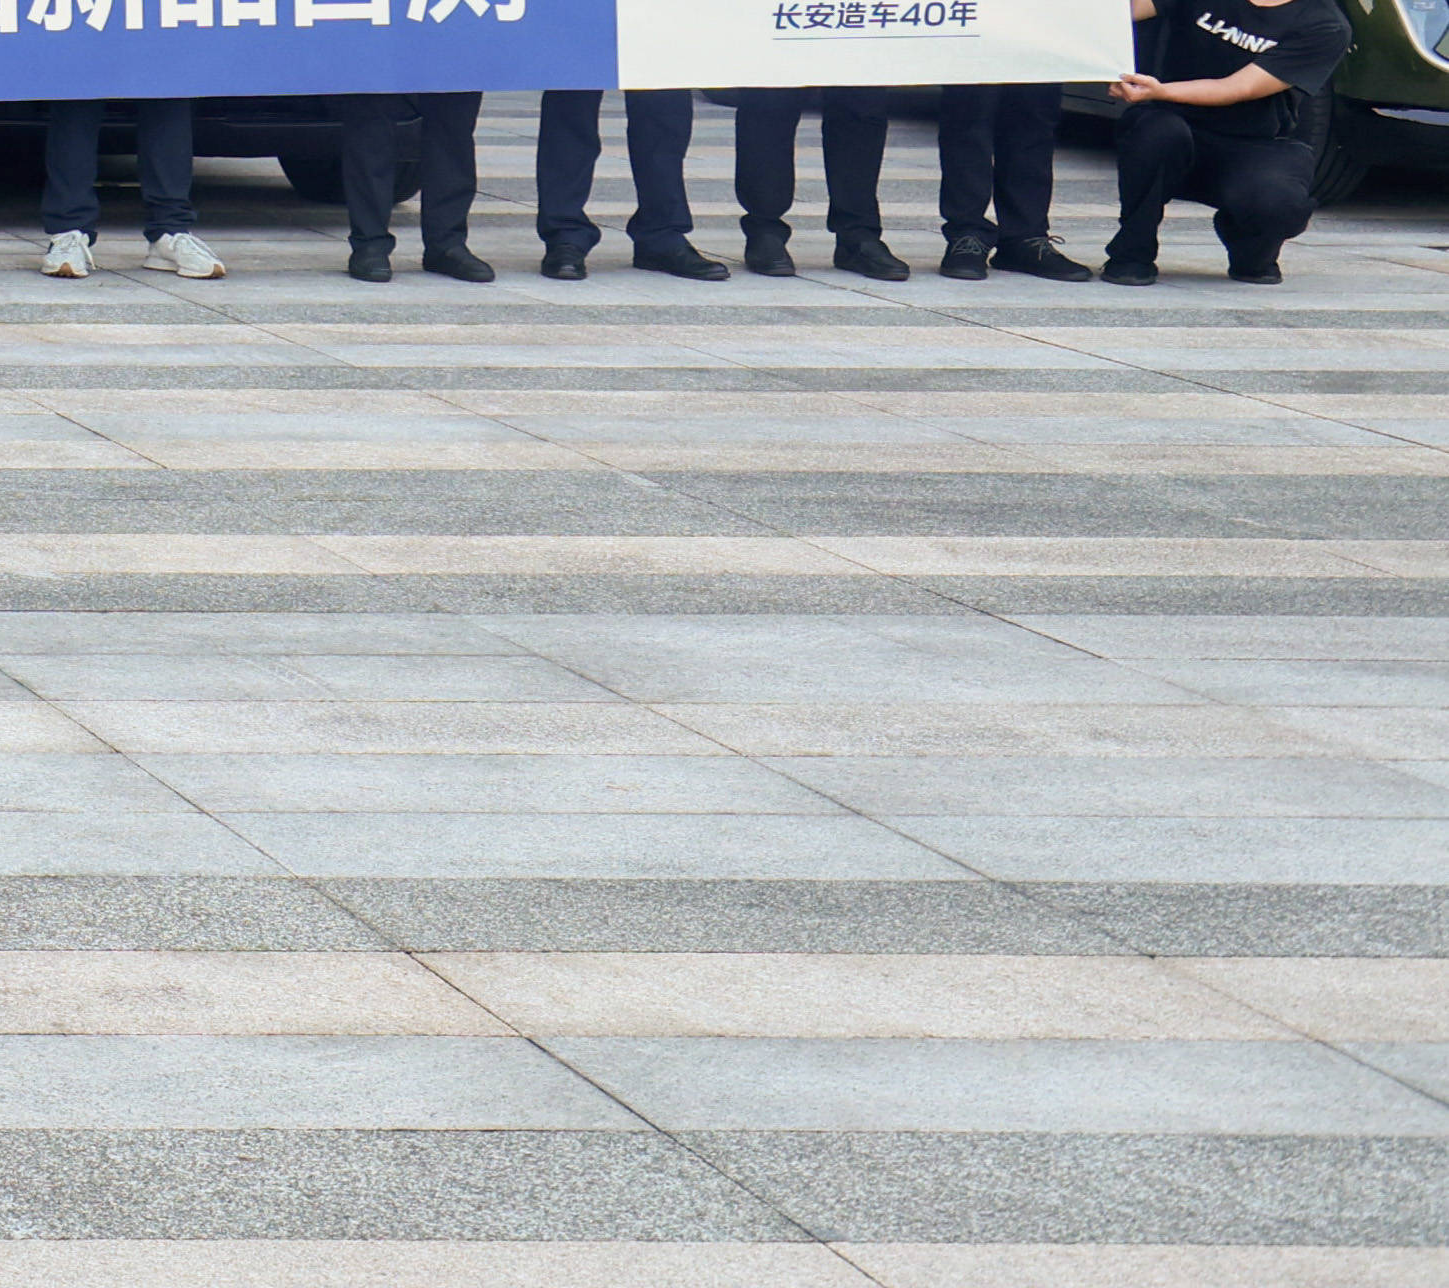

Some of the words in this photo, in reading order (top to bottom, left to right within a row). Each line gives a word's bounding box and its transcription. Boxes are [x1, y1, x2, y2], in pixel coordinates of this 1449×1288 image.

[772, 0, 978, 30] 长安造车40年
